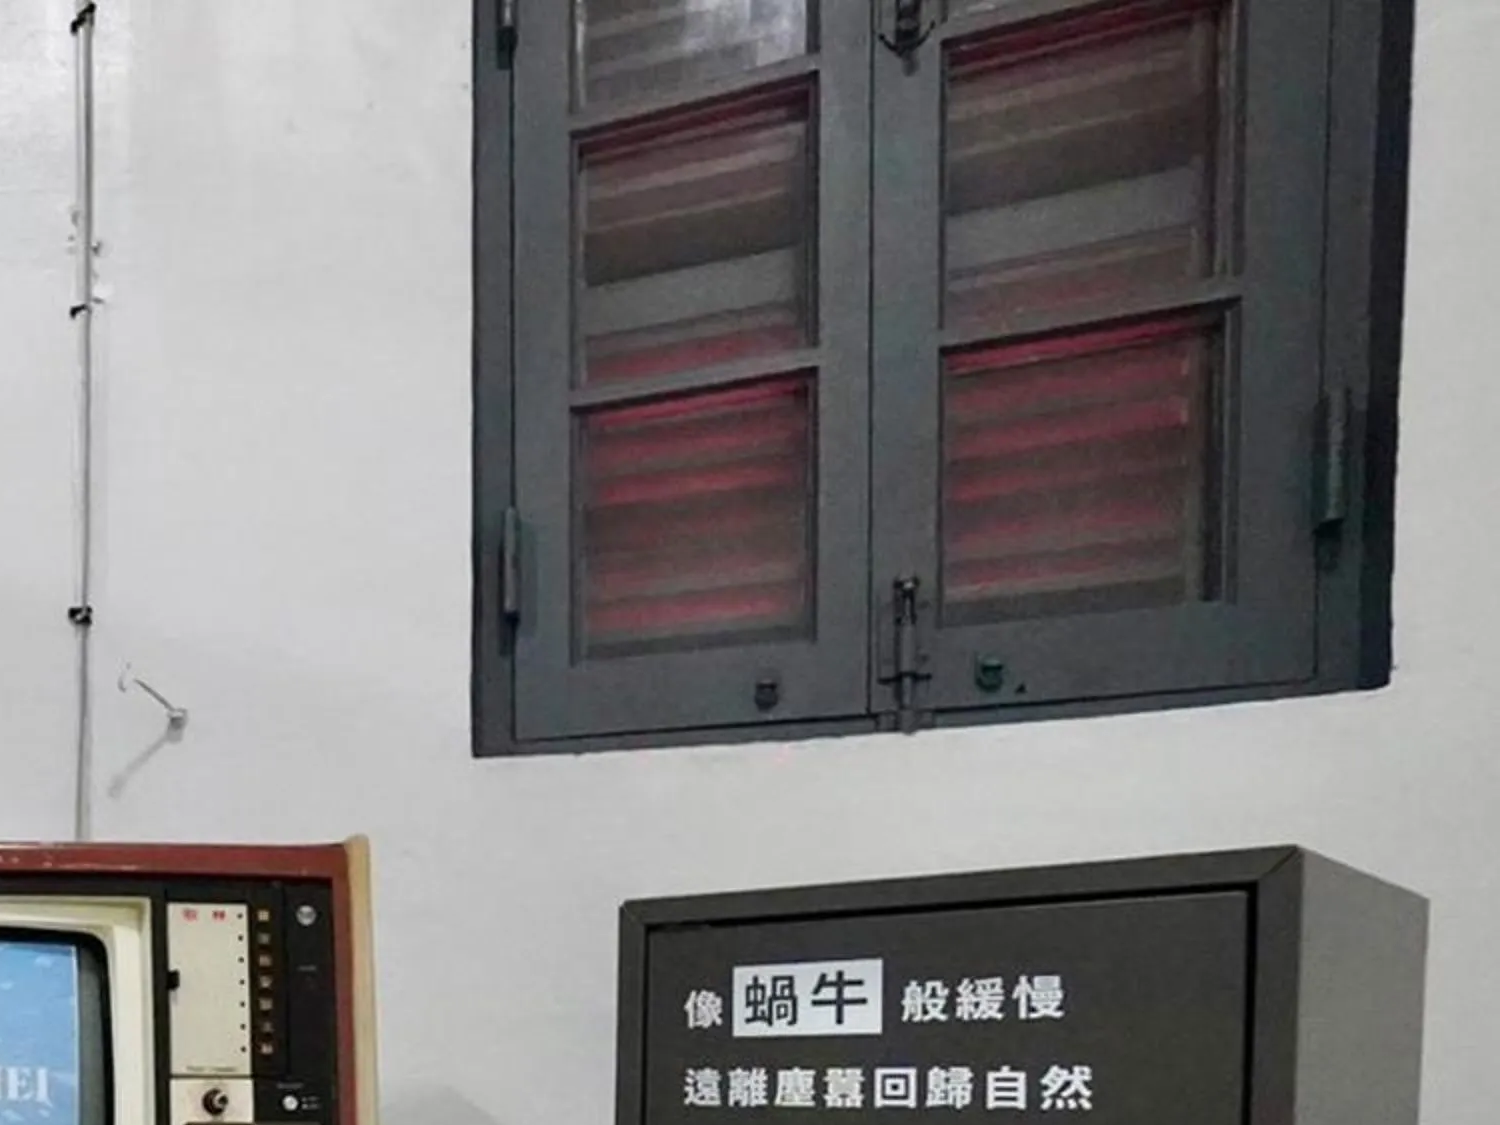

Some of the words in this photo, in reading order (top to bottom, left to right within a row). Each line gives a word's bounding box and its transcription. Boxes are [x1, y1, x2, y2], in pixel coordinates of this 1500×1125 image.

[684, 1064, 1093, 1110] 遠離塵囂回歸自然
